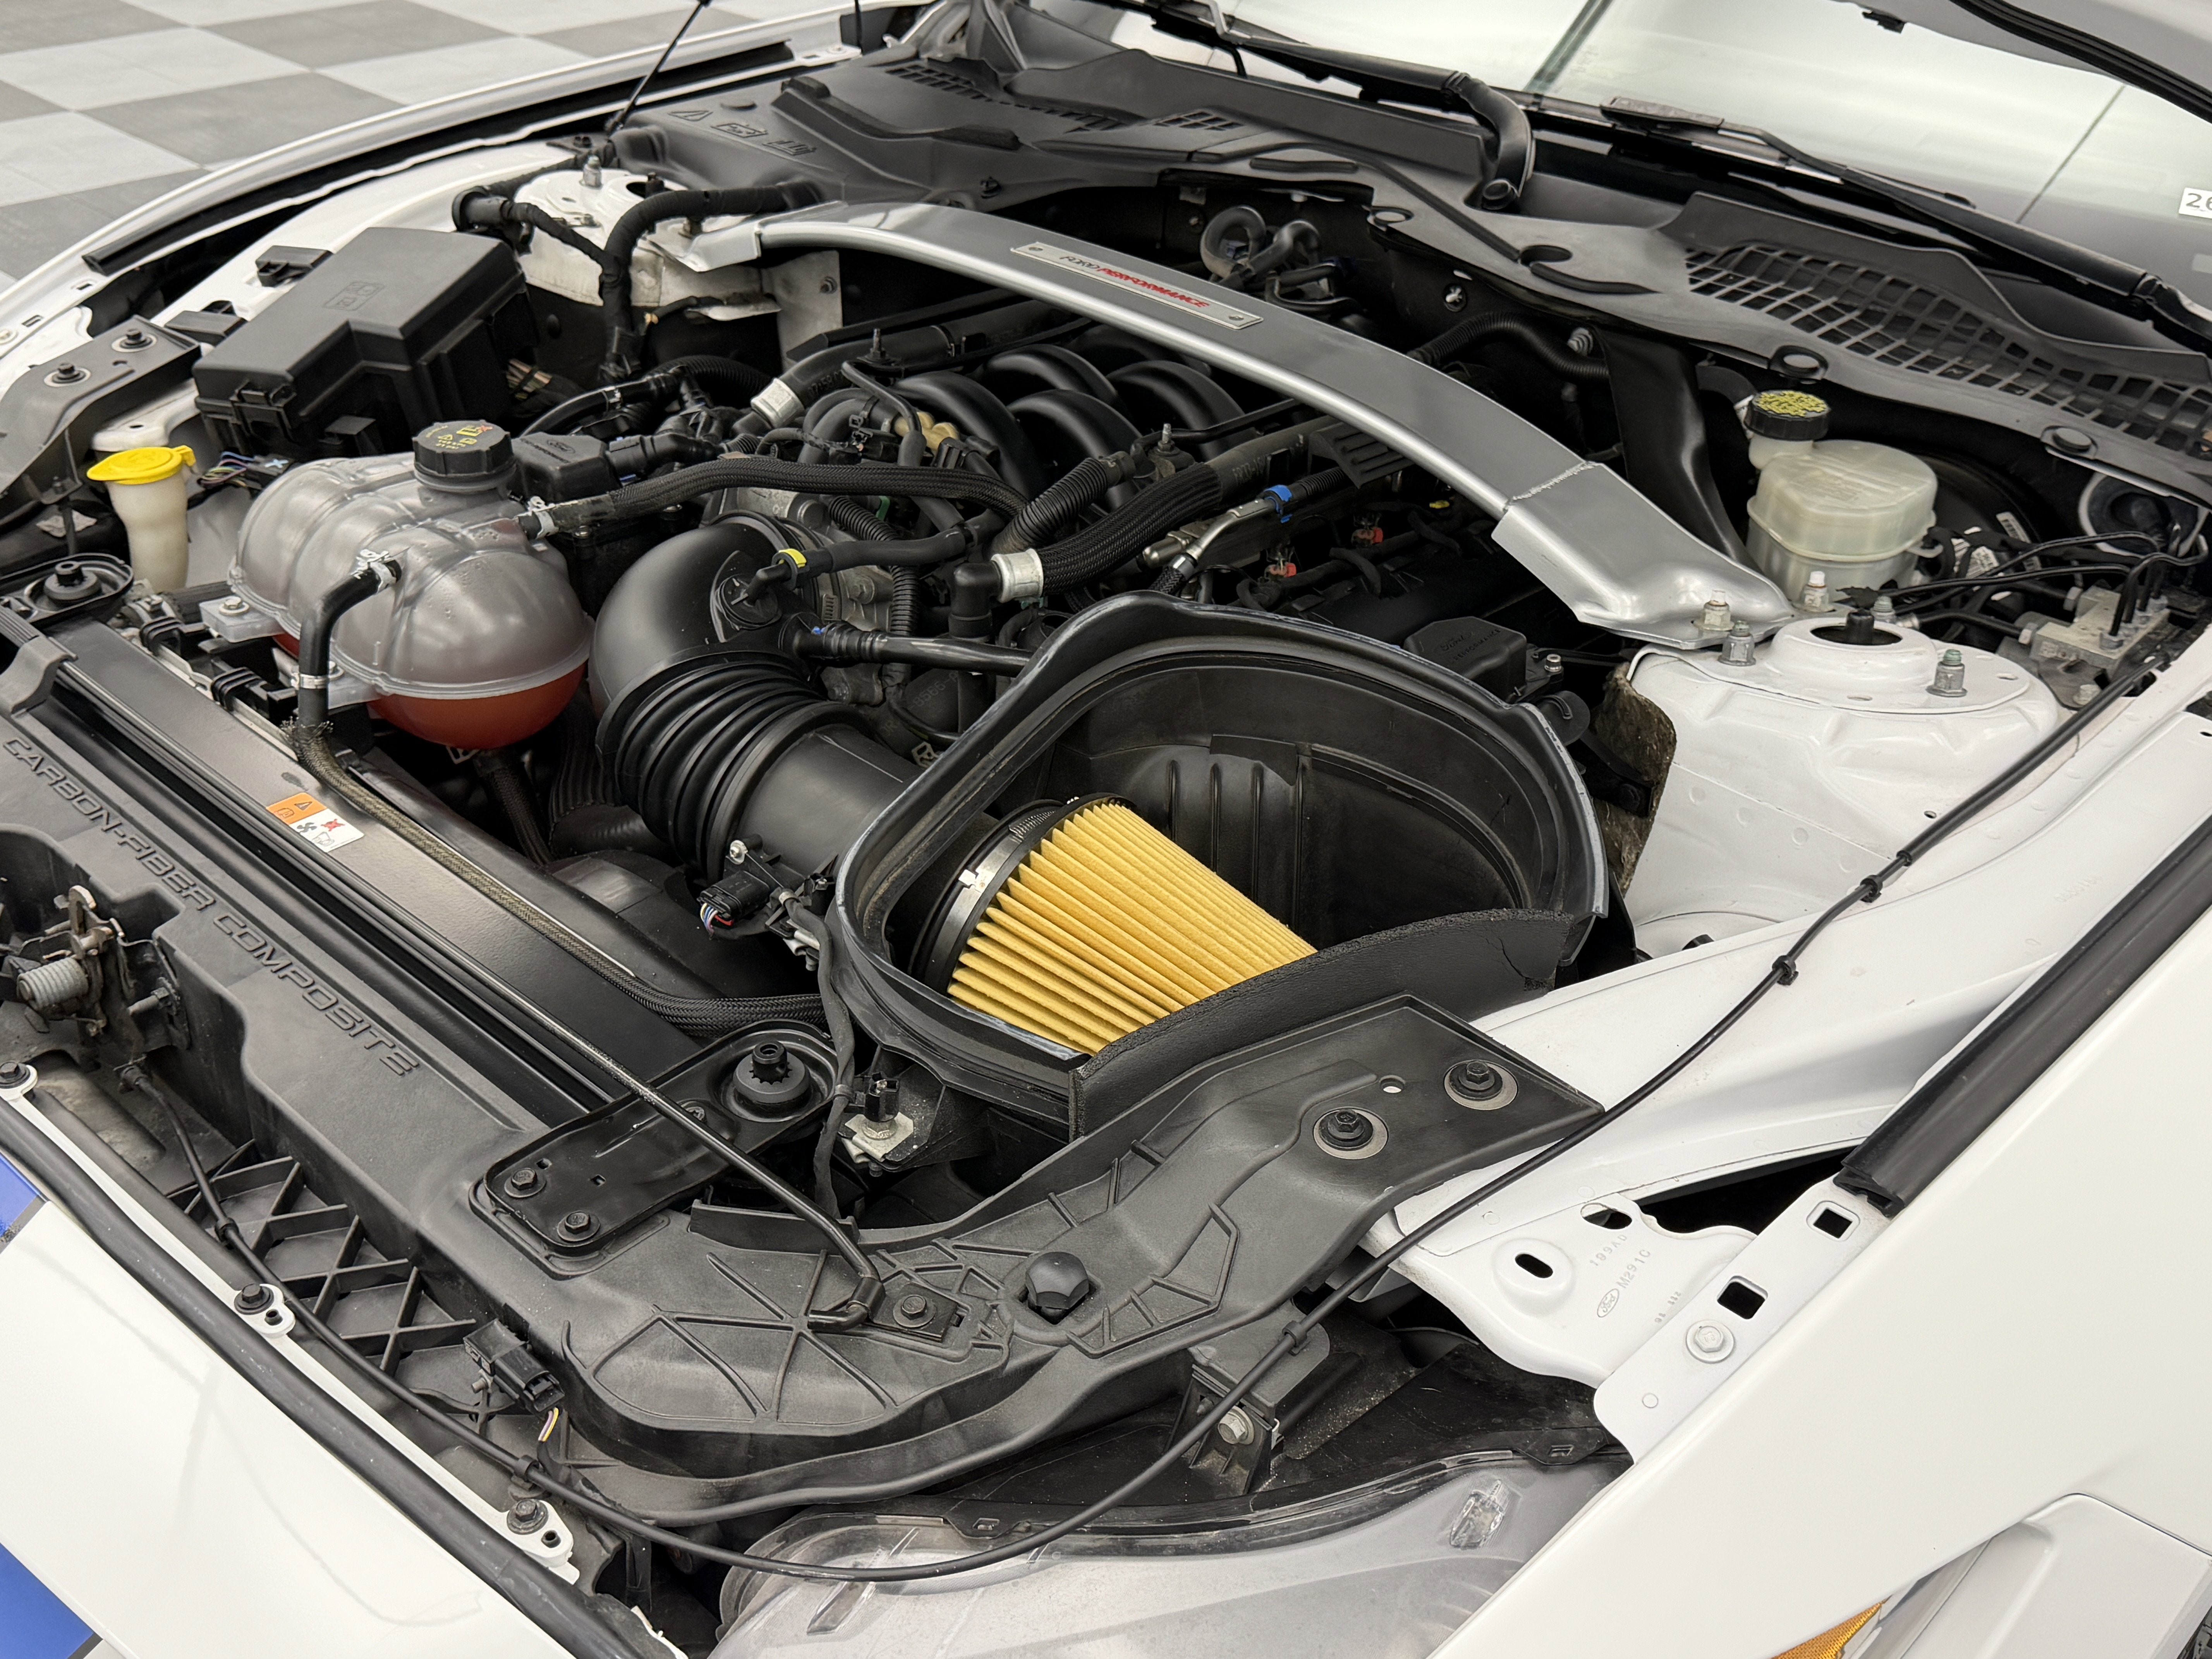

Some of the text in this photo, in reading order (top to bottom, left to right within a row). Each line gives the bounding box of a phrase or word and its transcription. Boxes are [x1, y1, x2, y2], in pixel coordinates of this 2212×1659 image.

[1097, 268, 1209, 308] PERFORMANCE
[3, 737, 420, 1076] CARBON-FIBER COMPOSITE
[1616, 1249, 1651, 1289] M291C
